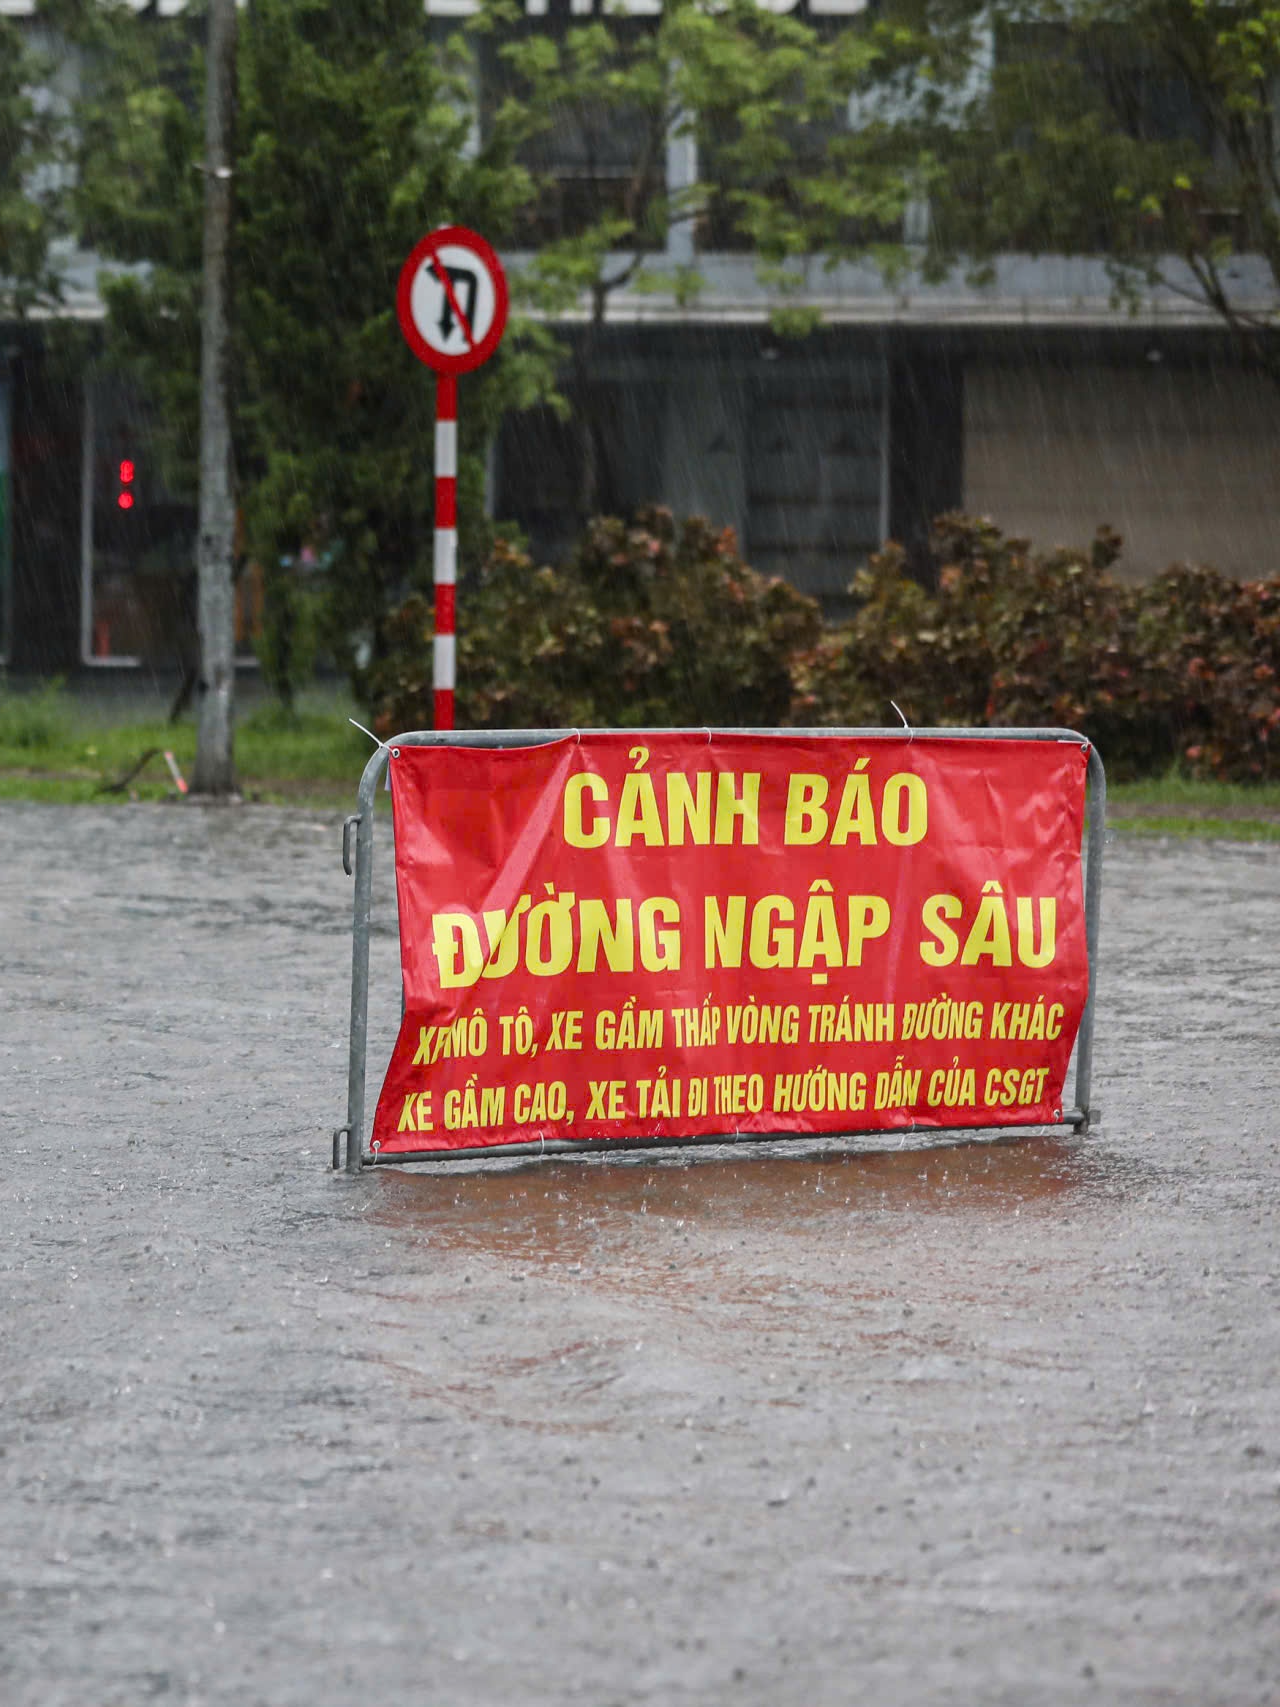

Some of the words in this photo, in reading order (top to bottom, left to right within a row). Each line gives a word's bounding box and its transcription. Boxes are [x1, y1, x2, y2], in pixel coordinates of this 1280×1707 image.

[563, 745, 761, 849] CẢNH
[783, 757, 929, 848] BÁO
[431, 881, 681, 989] ĐƯỜNG
[704, 878, 892, 985] NGẬP
[919, 880, 1058, 969] SÂU
[443, 1007, 488, 1058] MÔ
[498, 1006, 538, 1058] TÔ,
[545, 1010, 584, 1051] XE
[595, 995, 664, 1051] GẦM
[671, 992, 722, 1048] THẤP
[726, 995, 800, 1044] VÒNG
[808, 994, 895, 1043] TRÁNH
[900, 992, 984, 1041] ĐƯỜNG
[990, 995, 1065, 1041] KHÁC
[397, 1090, 434, 1132] XE
[444, 1073, 506, 1130] GẦM
[513, 1080, 575, 1126] CAO,
[585, 1080, 627, 1120] XE
[635, 1065, 681, 1119] TẢI
[687, 1077, 709, 1117] ĐI
[713, 1073, 764, 1115] THEO
[772, 1064, 868, 1113] HƯỚNG
[873, 1055, 923, 1110] DẪN
[927, 1055, 977, 1107] CỦA
[984, 1067, 1050, 1107] CSGT
